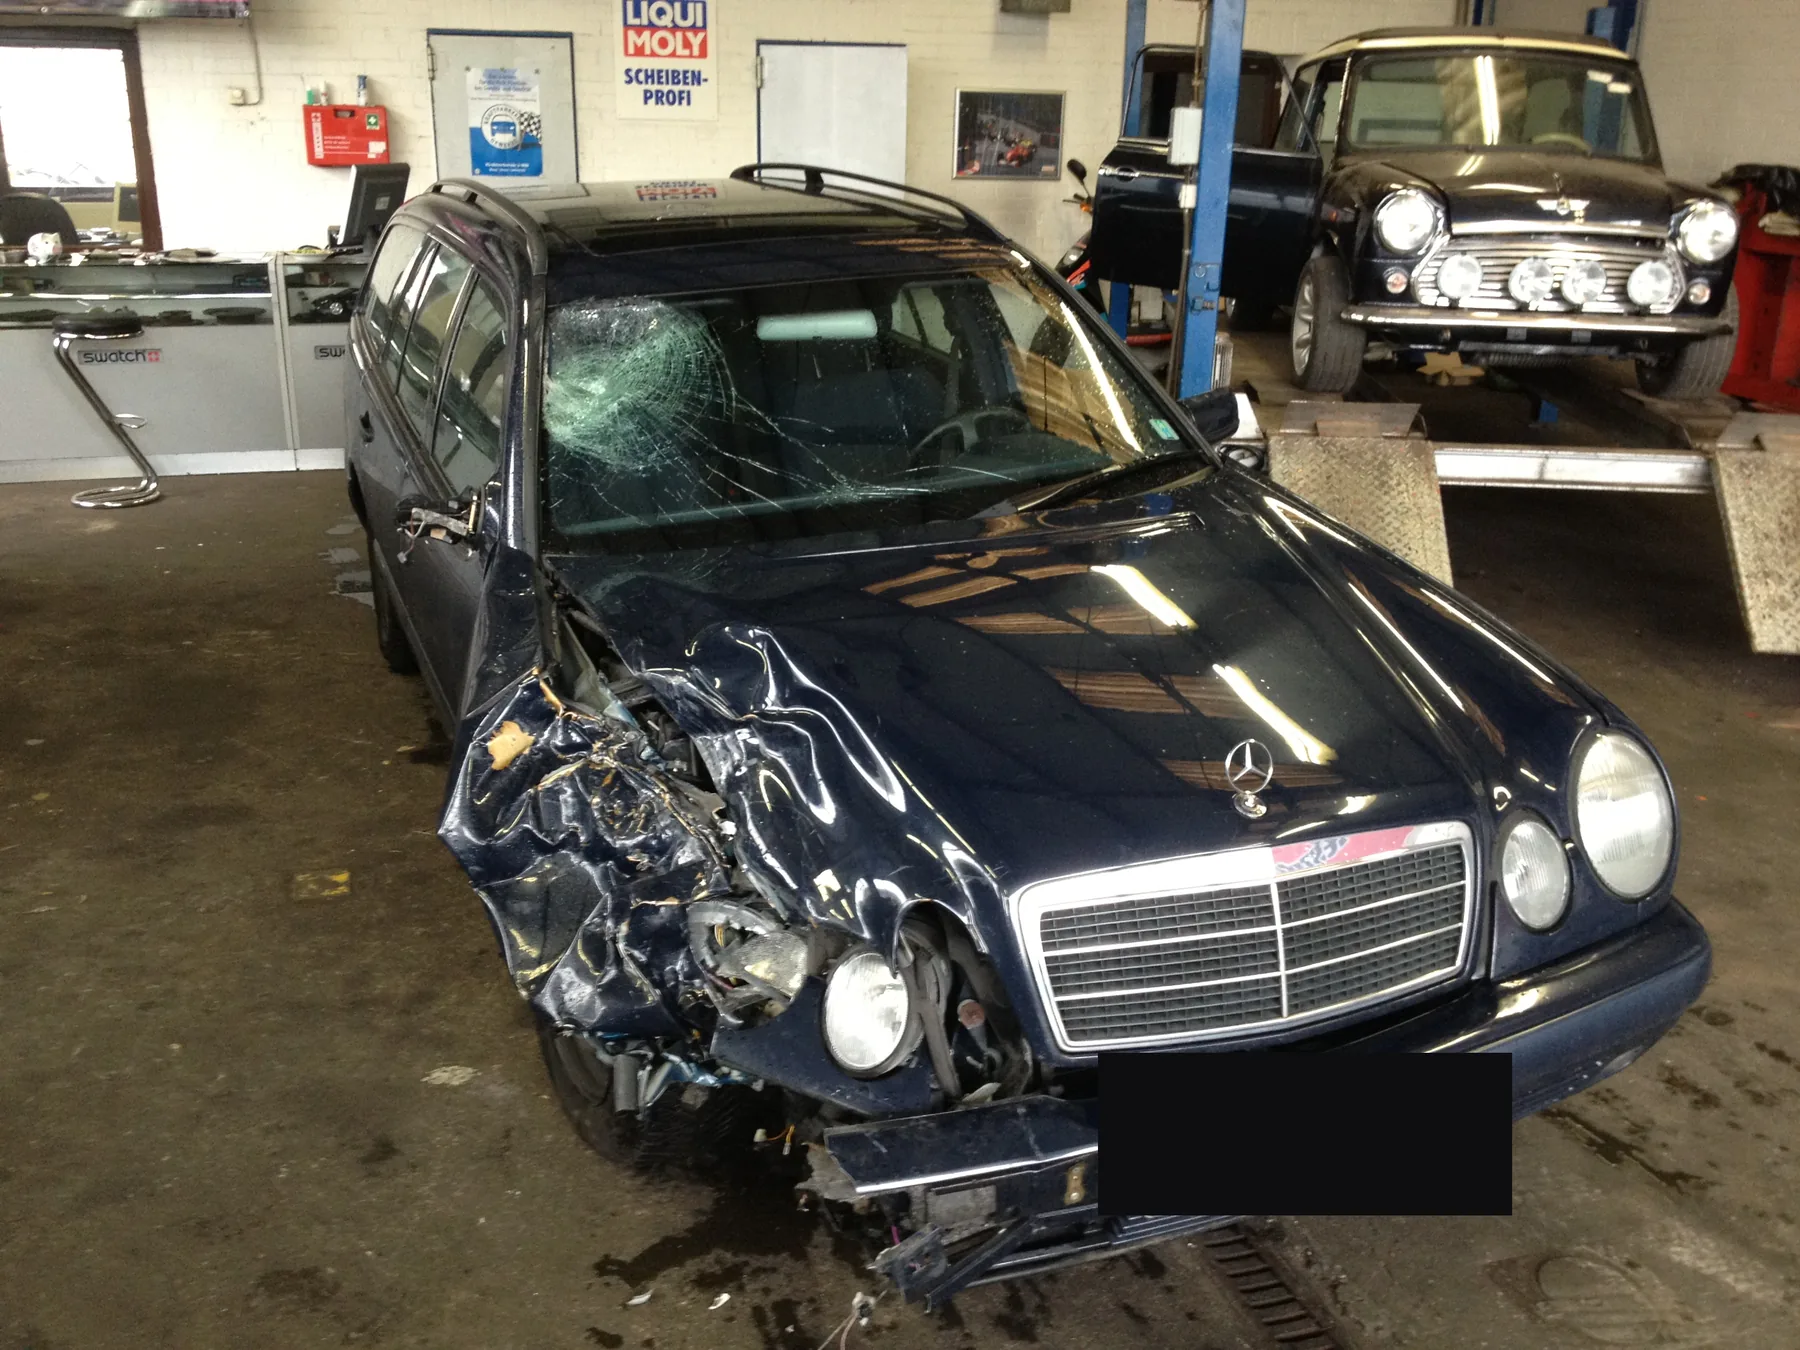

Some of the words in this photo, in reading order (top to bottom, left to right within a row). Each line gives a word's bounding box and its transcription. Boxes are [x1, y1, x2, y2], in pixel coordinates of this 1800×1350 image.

[626, 0, 704, 28] LIQUI
[627, 29, 706, 56] MOLY
[624, 68, 708, 86] SCHEIBEN-
[643, 89, 691, 106] PROFI
[83, 349, 146, 363] swatch
